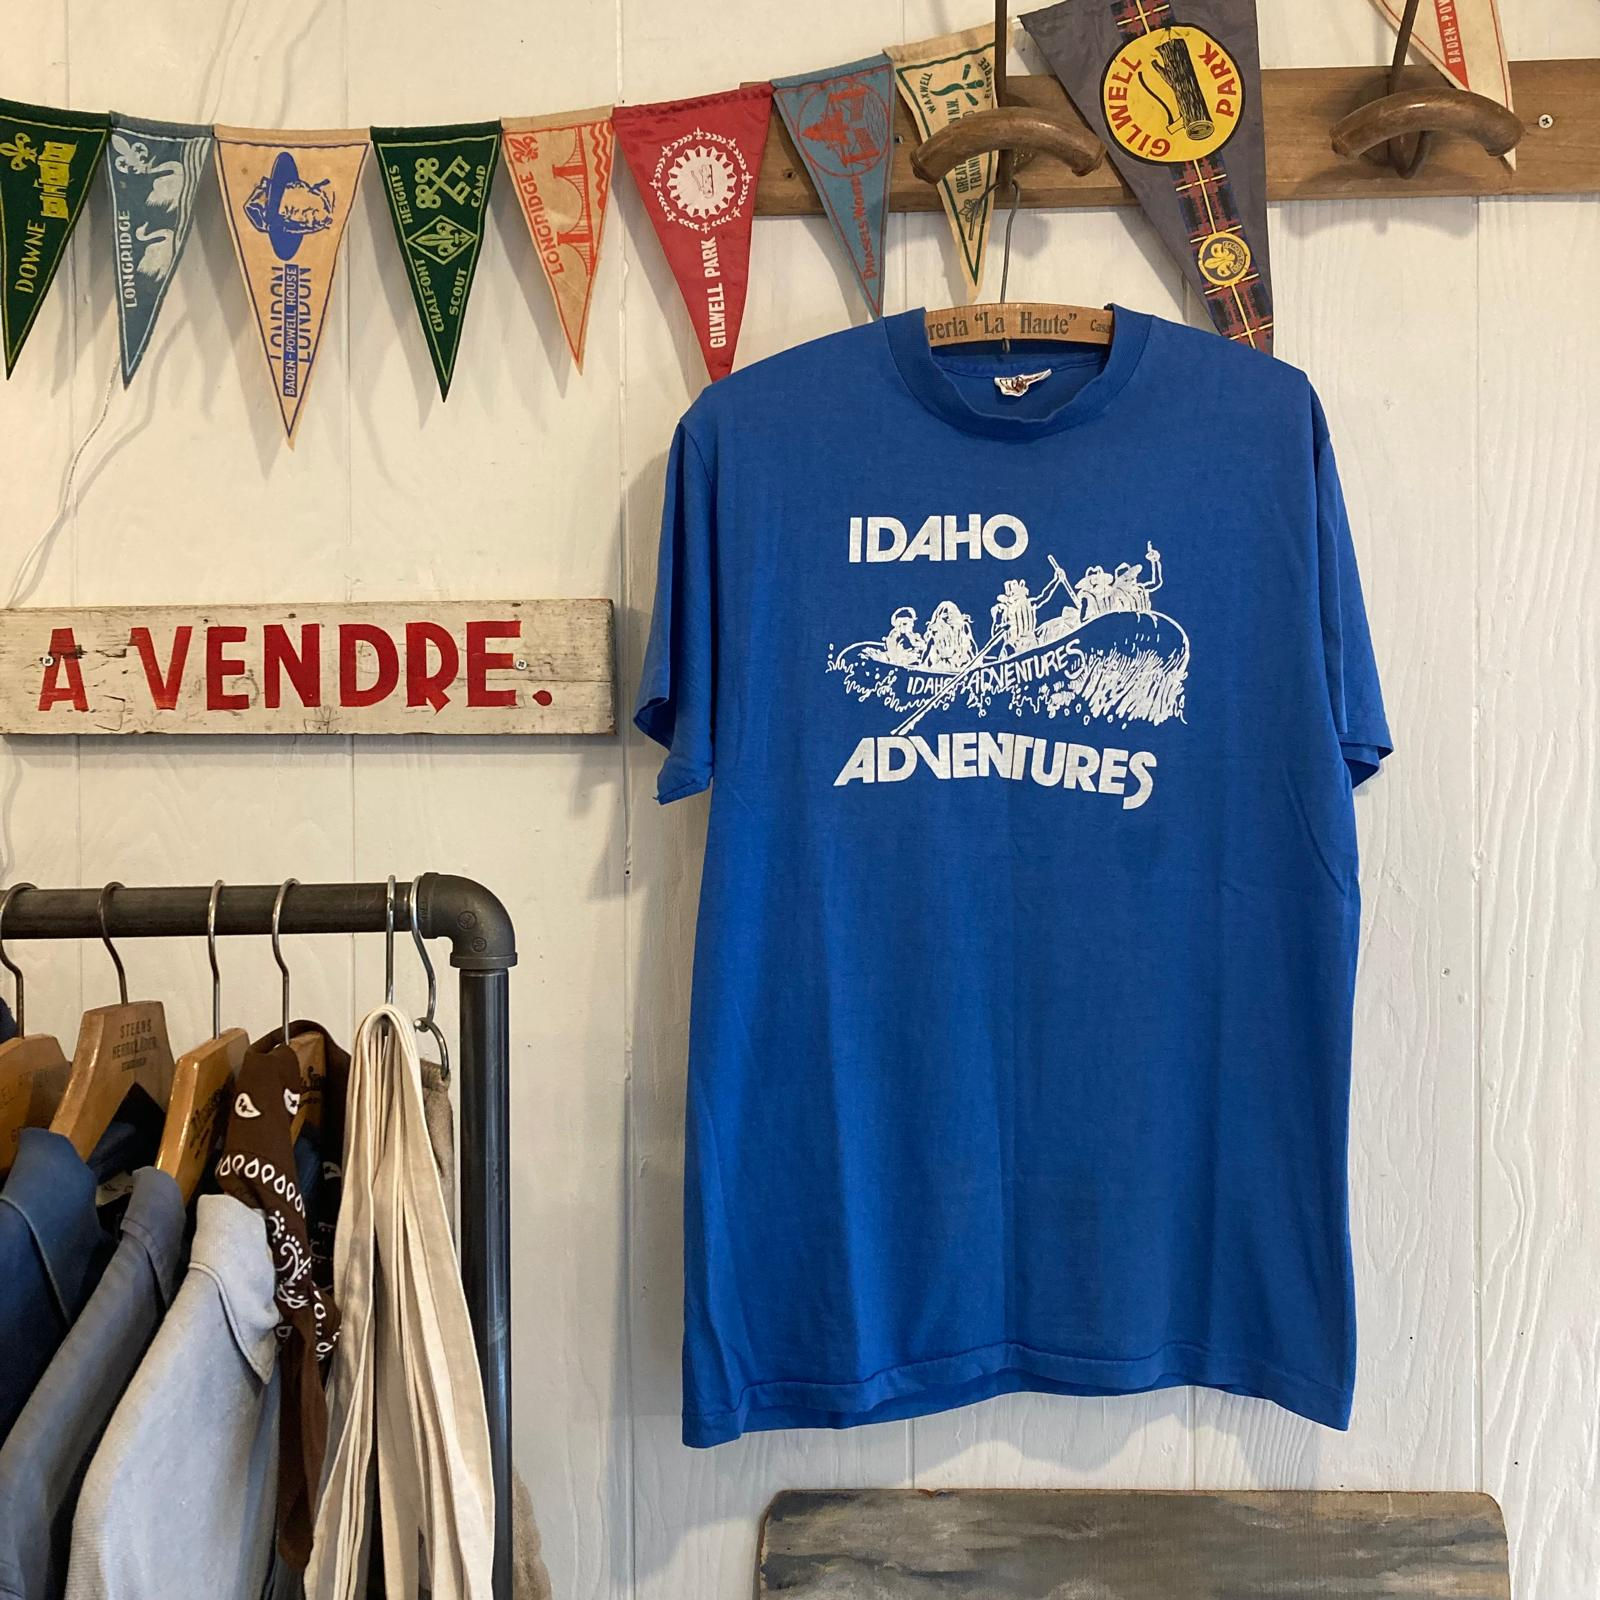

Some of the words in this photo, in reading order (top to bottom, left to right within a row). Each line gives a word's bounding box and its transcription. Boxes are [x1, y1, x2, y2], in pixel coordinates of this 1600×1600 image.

[1109, 57, 1171, 157] GILWELL
[1198, 42, 1237, 118] PARK
[389, 164, 413, 225] HEIGHTS
[519, 170, 565, 277] LONGRIDGE
[15, 220, 46, 294] DOWNE
[118, 209, 138, 308] LONGRIDGE
[286, 266, 297, 305] HOUSE
[449, 267, 467, 316] SCOUT
[700, 236, 721, 278] PARK
[414, 258, 445, 333] CHALFONT
[708, 282, 727, 349] GILWELL
[849, 513, 1029, 563] IDAHO
[38, 627, 89, 711] A
[960, 638, 1086, 694] ADVENTURES
[833, 731, 1157, 811] ADVENTURES
